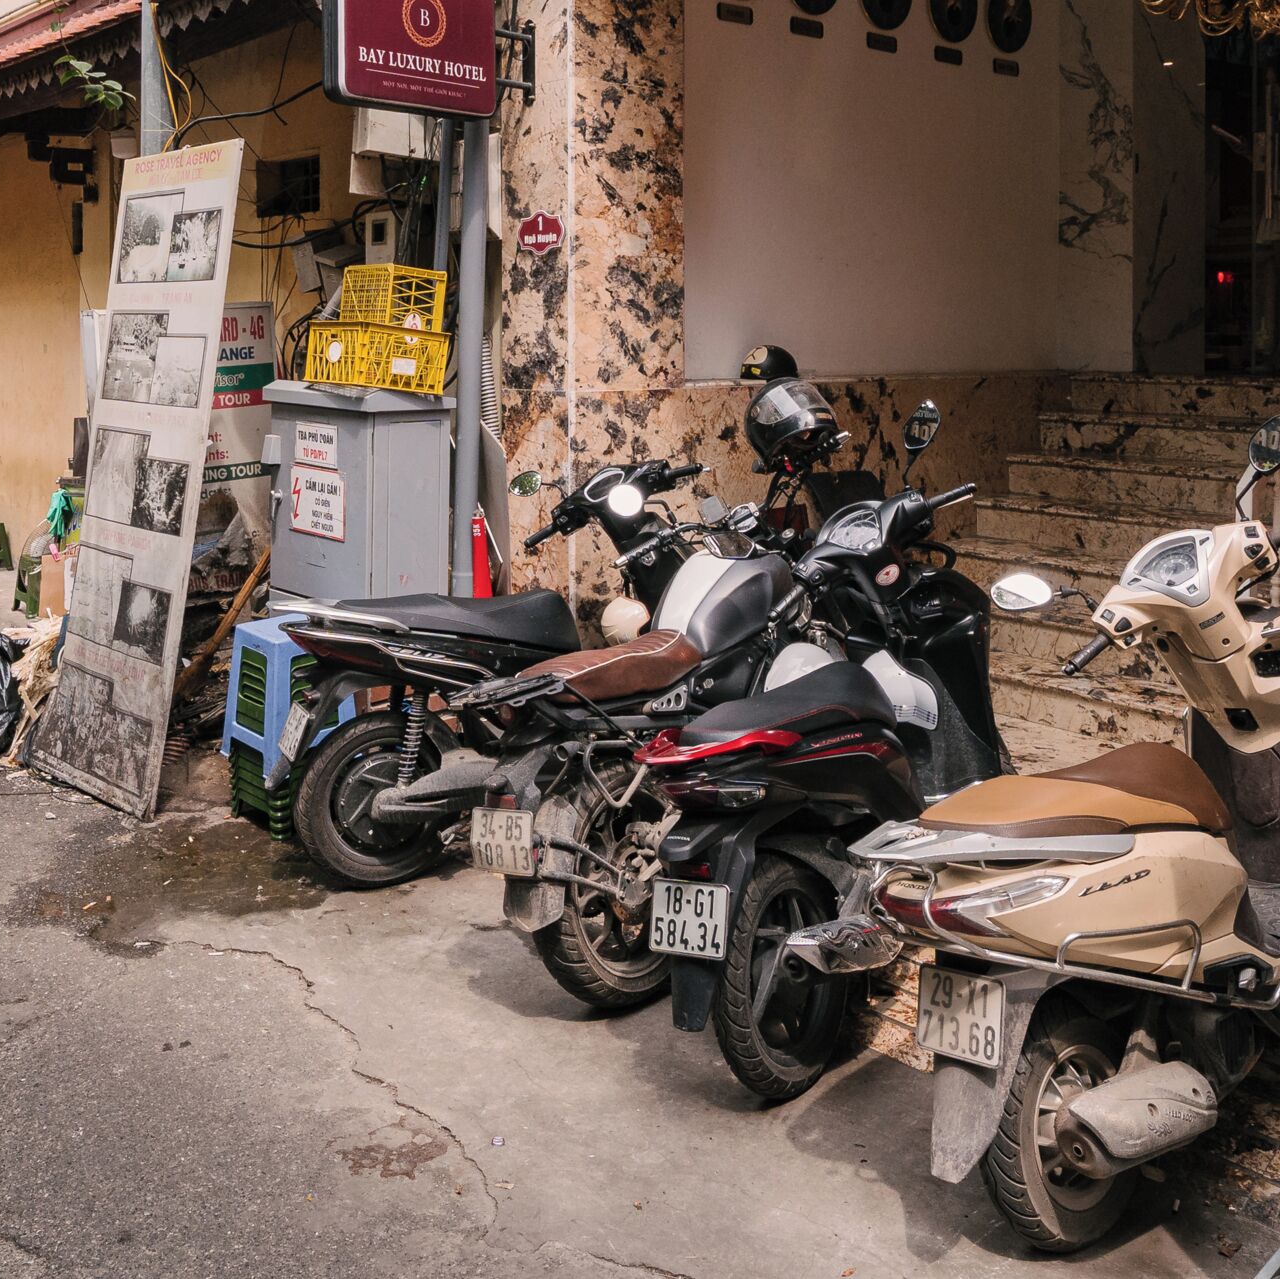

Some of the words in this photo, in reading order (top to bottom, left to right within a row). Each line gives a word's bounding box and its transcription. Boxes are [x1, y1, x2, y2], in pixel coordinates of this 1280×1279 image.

[420, 8, 431, 28] B
[358, 46, 385, 65] BAY
[388, 51, 442, 74] LUXURY
[444, 61, 487, 82] HOTEL
[135, 161, 155, 173] ROSE
[186, 148, 224, 166] AGENCY
[537, 215, 543, 231] 1
[250, 314, 265, 341] 4G
[219, 392, 251, 407] TOUR
[230, 463, 262, 478] TOUR
[1078, 869, 1151, 898] LEAD
[665, 885, 715, 919] 18-G1
[654, 916, 721, 955] 584.34
[930, 972, 990, 1019] 29-X1
[922, 1008, 996, 1061] 713.68
